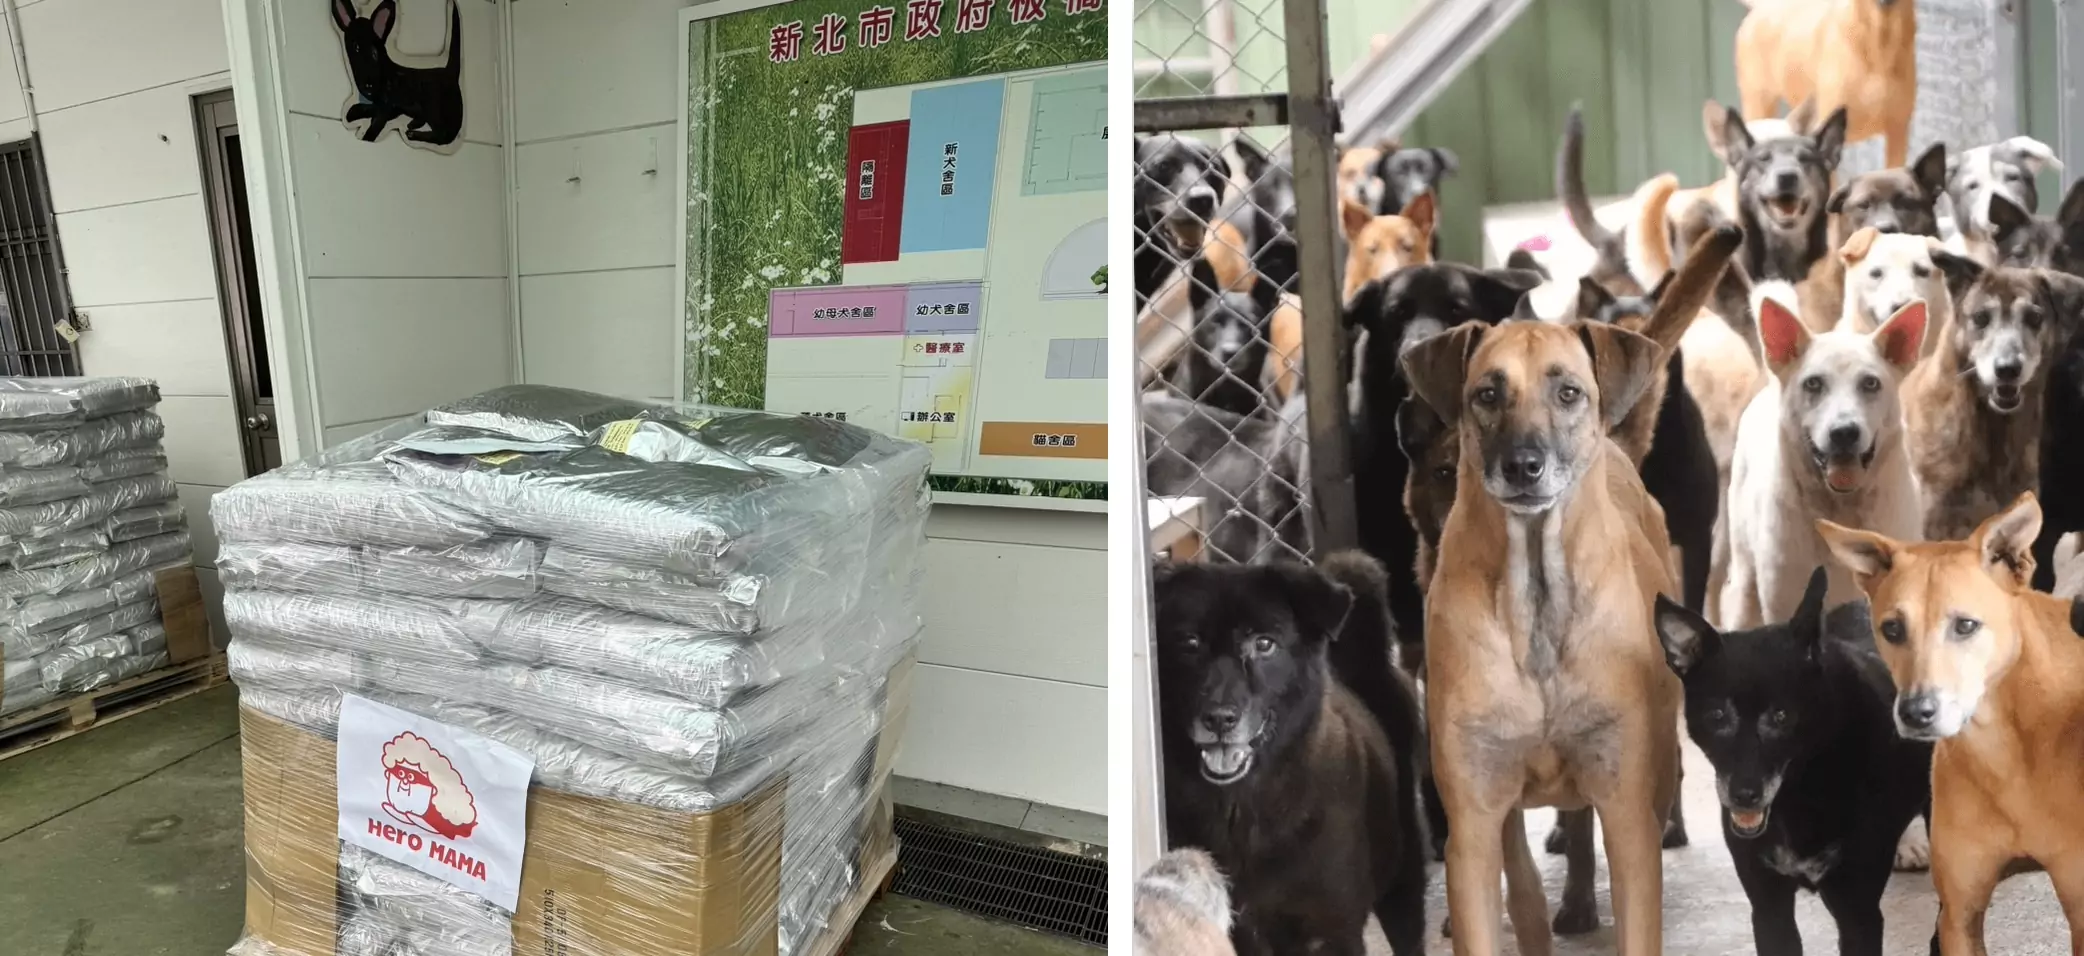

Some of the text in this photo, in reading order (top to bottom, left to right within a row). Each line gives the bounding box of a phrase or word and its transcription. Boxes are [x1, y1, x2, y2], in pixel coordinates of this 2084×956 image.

[940, 142, 958, 196] 新犬舍區
[813, 306, 875, 319] 幼母犬舍區
[916, 303, 970, 316] 幼犬舍區
[925, 342, 965, 354] 醫療室
[916, 411, 956, 423] 辦公室
[1033, 434, 1076, 446] 貓舍區
[367, 817, 487, 882] Hero MAMA
